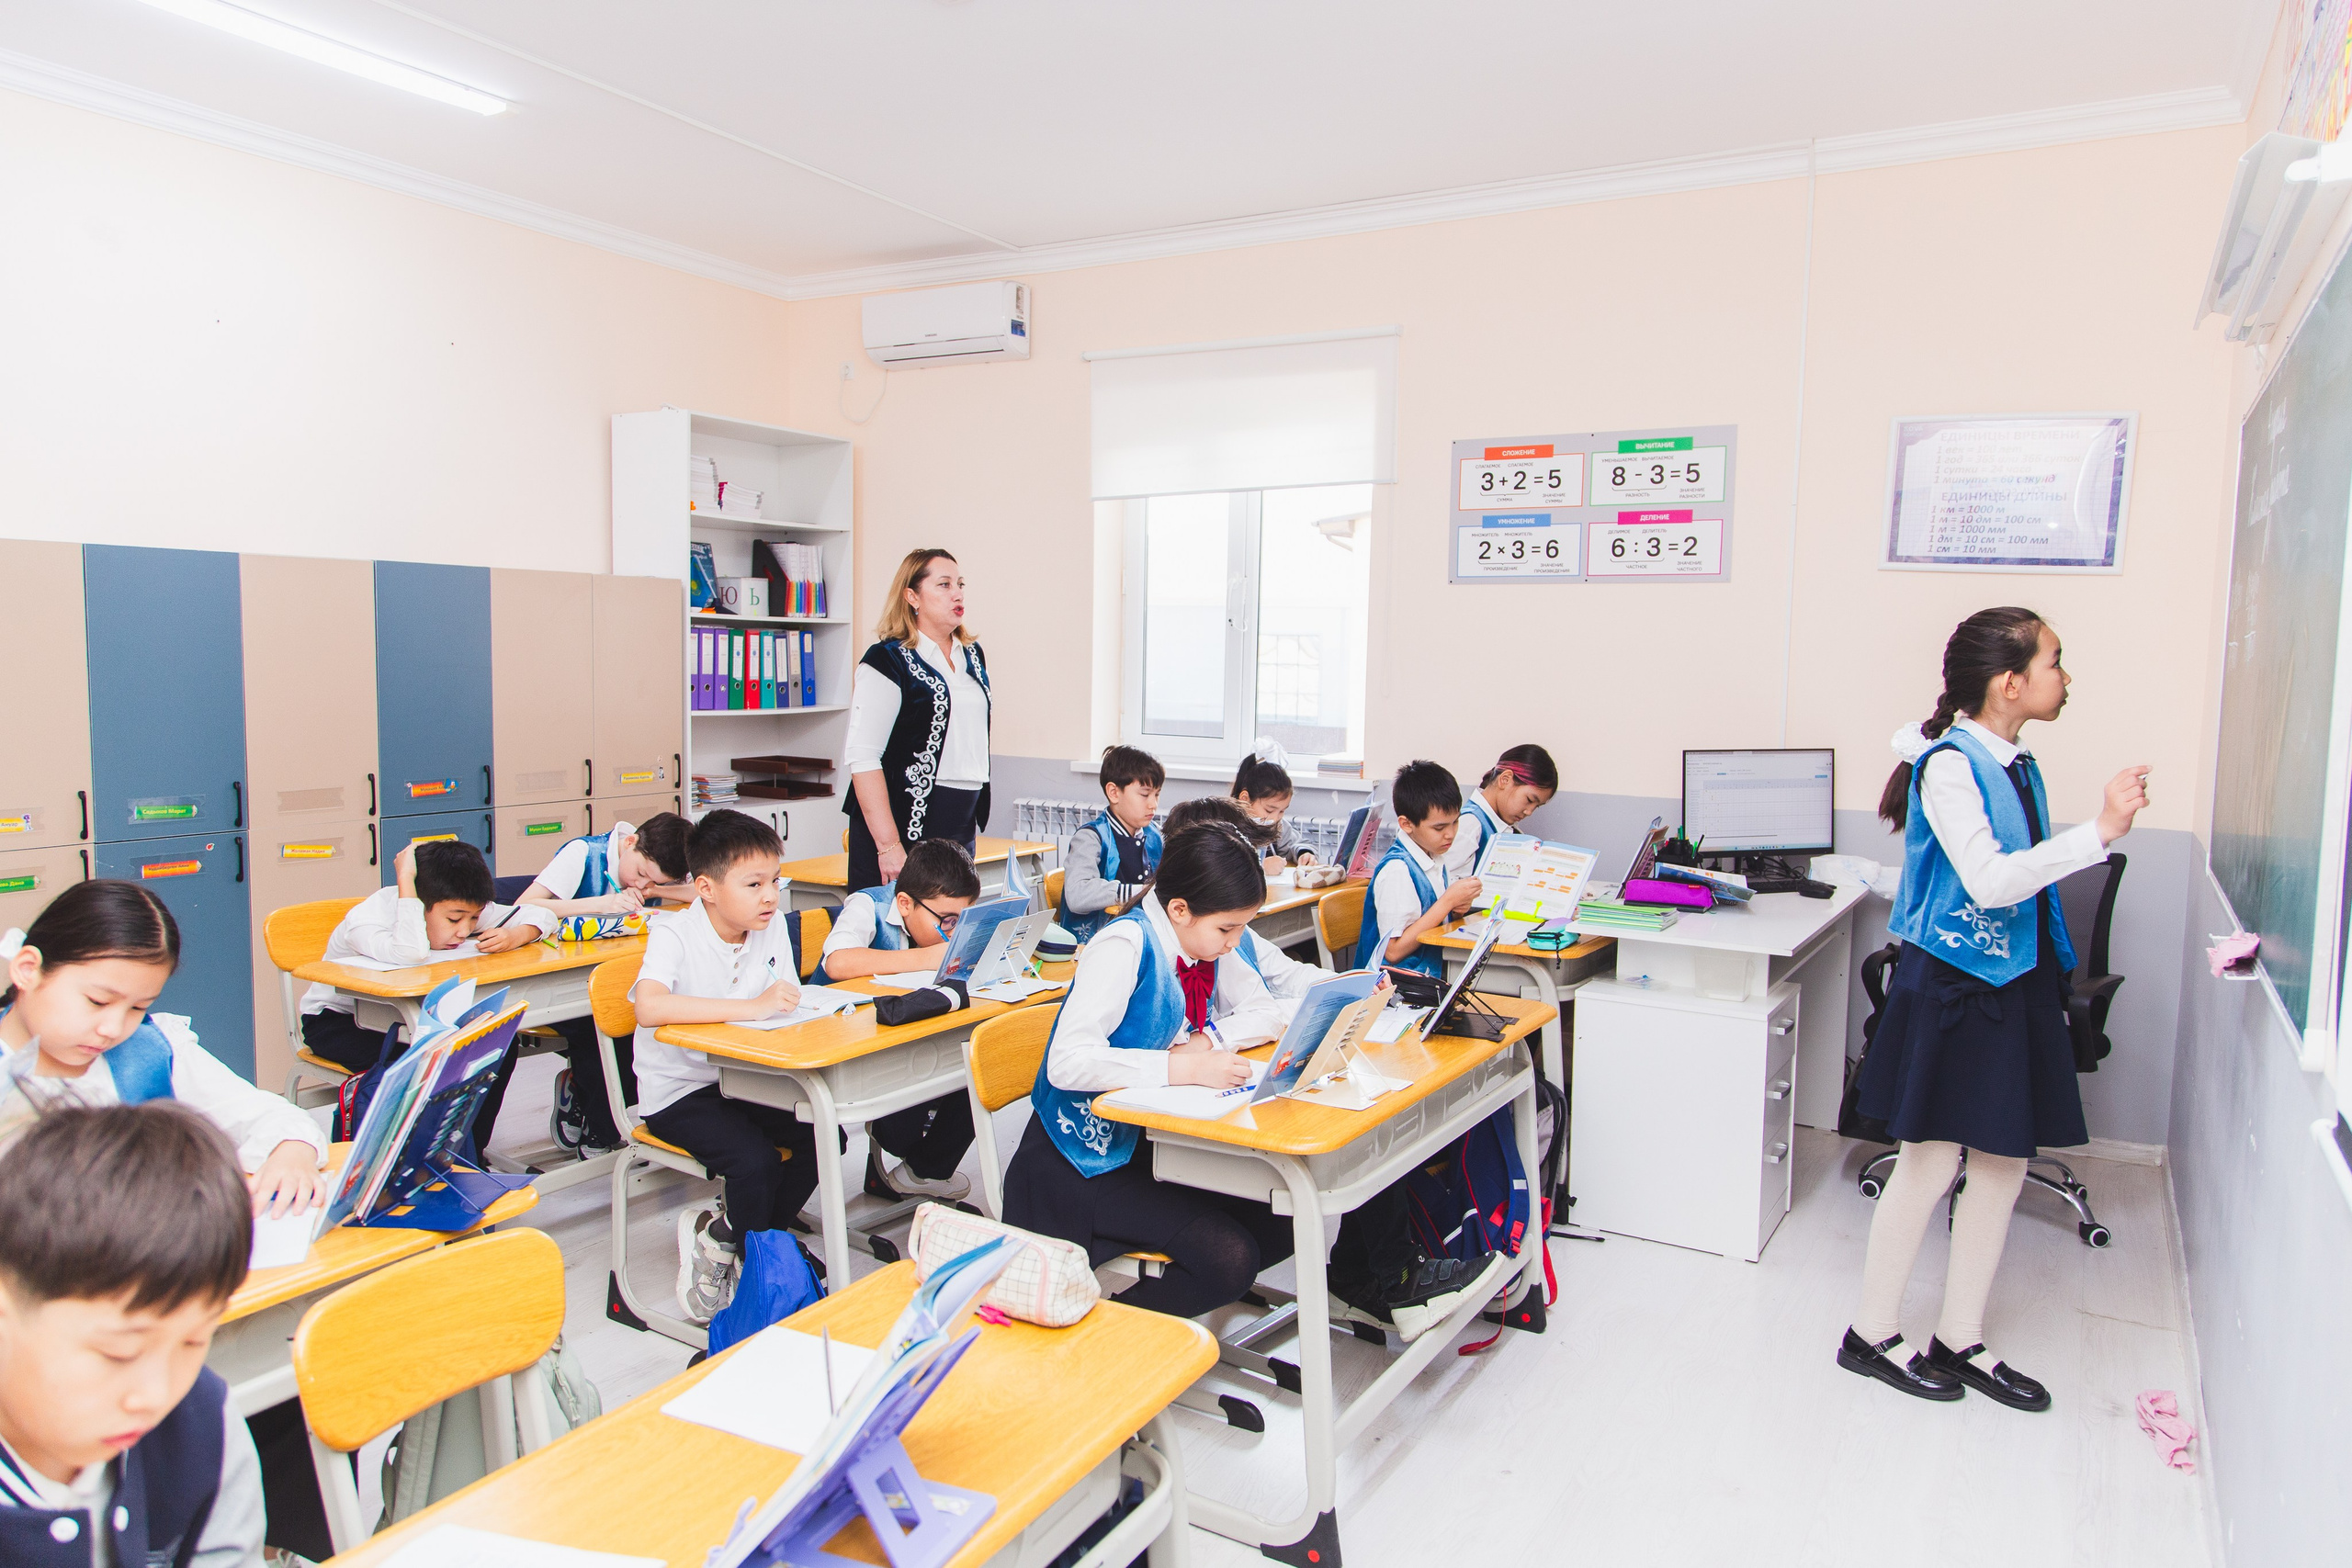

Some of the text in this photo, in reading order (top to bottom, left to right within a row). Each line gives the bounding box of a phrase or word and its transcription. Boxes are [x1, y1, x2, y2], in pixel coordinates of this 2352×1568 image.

[1941, 430, 2079, 442] ЕДИНИЦЫ ВРЕМЕНИ
[1635, 441, 1675, 449] ВЫЧИТАНИЕ
[1937, 446, 1942, 454] 1
[1936, 456, 1941, 464] 1
[1944, 455, 1963, 464] год
[1976, 455, 1995, 463] 365
[2044, 456, 2081, 465] суток
[1611, 467, 1625, 486] 8
[1650, 465, 1664, 485] 3
[1686, 463, 1700, 483] 5
[1935, 466, 1940, 474] 1
[1944, 468, 1978, 476] сутки
[1481, 472, 1493, 491] 3
[1513, 470, 1526, 490] 2
[1548, 469, 1561, 489] 5
[1934, 476, 1939, 484] 1
[1942, 477, 1988, 485] минута
[2017, 474, 2055, 485] секунд
[1941, 492, 2067, 502] ЕДИНИЦЫ ДЛИНЫ
[1931, 505, 1937, 513] 1
[1967, 505, 1994, 513] 1000
[1640, 513, 1669, 522] ДЕЛЕНИЕ
[1960, 515, 1973, 524] 10
[1975, 515, 1991, 524] дм
[2004, 515, 2025, 524] 100
[1959, 525, 1985, 533] 1000
[1928, 535, 1934, 543] 1
[1938, 535, 1952, 543] дм
[1964, 535, 1978, 543] 10
[2007, 536, 2028, 544] 100
[1478, 541, 1491, 559] 2
[1511, 540, 1524, 559] 3
[1545, 539, 1559, 558] 6
[1611, 538, 1625, 558] 6
[1646, 537, 1661, 557] 3
[1683, 536, 1697, 556] 2
[1928, 545, 1933, 553] 1
[1962, 545, 1975, 553] 10
[720, 586, 738, 605] Ю
